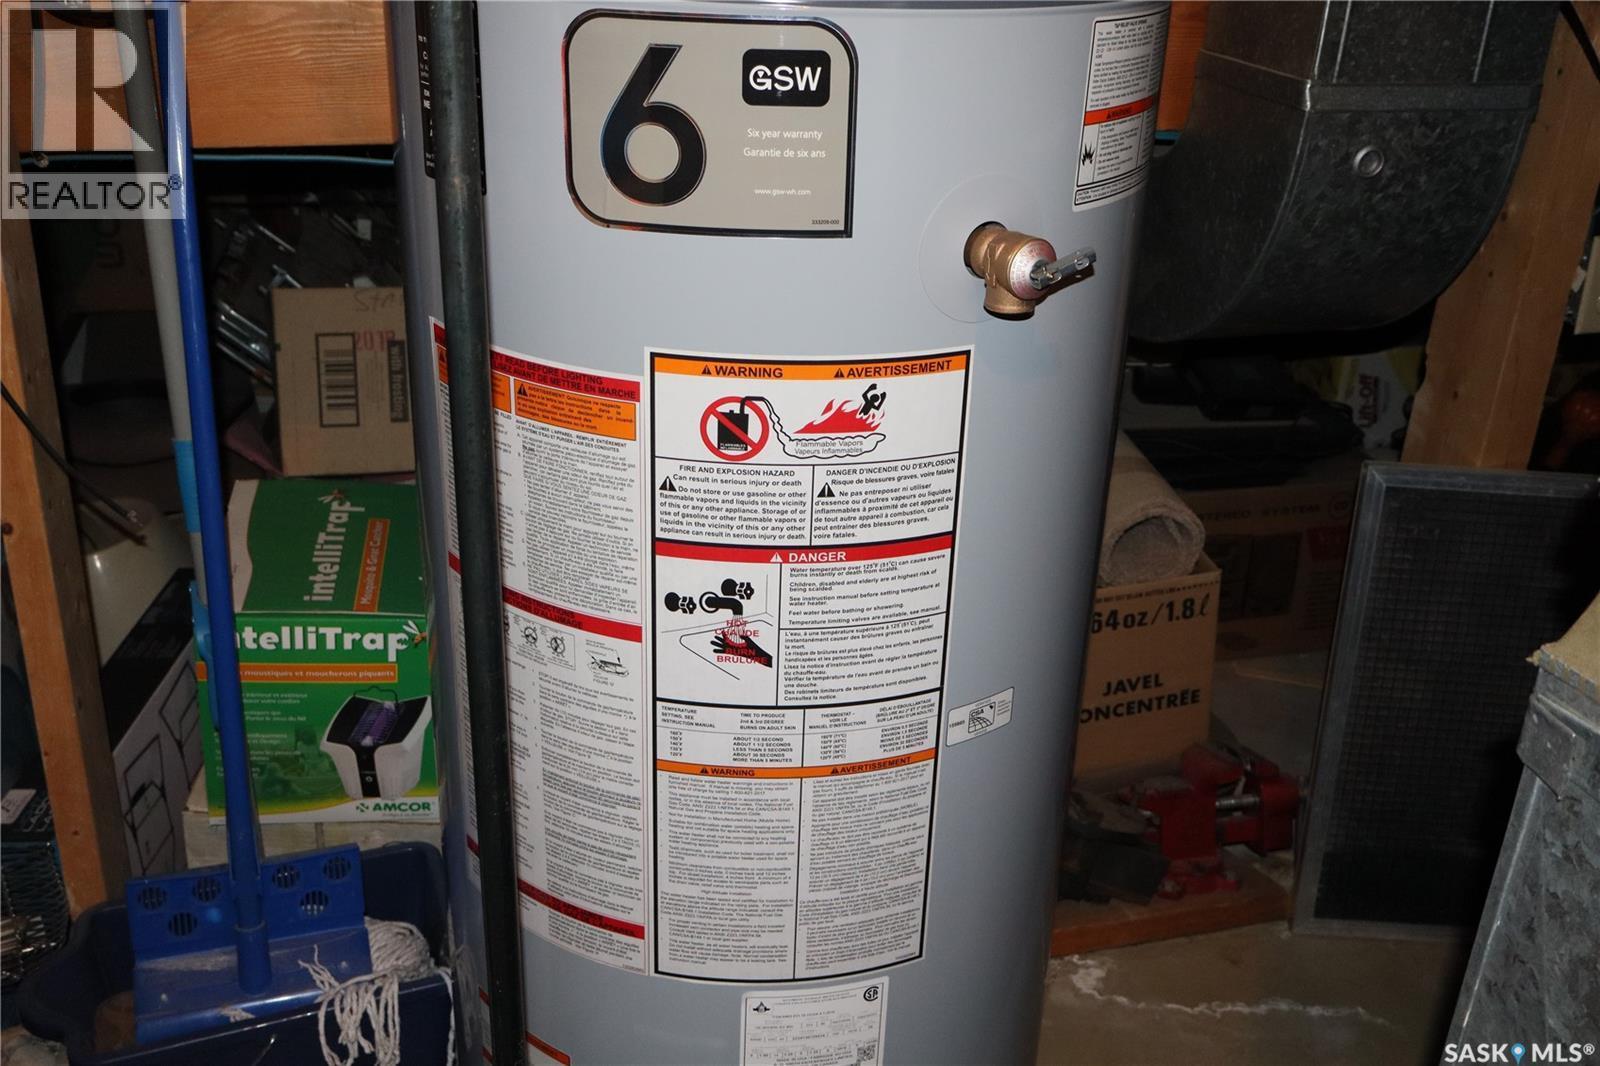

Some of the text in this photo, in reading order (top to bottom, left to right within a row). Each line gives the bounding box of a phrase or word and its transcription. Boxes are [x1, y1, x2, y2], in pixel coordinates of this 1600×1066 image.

[601, 43, 822, 206] 6 GSW
[747, 128, 823, 141] Six year warranty
[744, 147, 826, 158] Garantie de six ans
[715, 360, 952, 378] WARNING AVERTISSEMENT
[562, 370, 603, 385] LIGHTING
[584, 383, 596, 392] EN
[599, 386, 636, 399] MARCHE
[839, 440, 864, 448] Vapors
[716, 468, 761, 476] EXPLOSION
[859, 466, 898, 474] D'INCENDIE
[912, 459, 956, 470] D'EXPLOSION
[673, 473, 687, 481] Can
[720, 477, 747, 485] serious
[749, 478, 770, 488] injury
[831, 478, 854, 487] Risque
[920, 470, 935, 478] voire
[936, 467, 954, 476] fatales
[746, 490, 776, 499] gasoline
[864, 487, 900, 496] entreposer
[910, 482, 932, 490] utiliser
[891, 494, 916, 503] vapeurs
[928, 487, 952, 498] liquides
[660, 491, 694, 502] flammable
[696, 497, 719, 505] vapors
[736, 498, 759, 507] liquids
[782, 499, 806, 508] vicinity
[815, 506, 860, 514] inflammables
[868, 502, 898, 514] proximité
[909, 500, 919, 508] cet
[920, 495, 944, 507] appareil
[668, 501, 680, 509] this
[691, 505, 704, 513] any
[762, 507, 788, 516] Storage
[681, 512, 709, 520] gasoline
[858, 512, 883, 522] appareil
[937, 503, 949, 512] cela
[660, 516, 684, 526] liquids
[694, 520, 706, 528] the
[708, 522, 734, 532] vicinity
[786, 524, 805, 532] other
[660, 526, 690, 535] appliance
[705, 530, 723, 538] result
[758, 532, 777, 542] injury
[304, 500, 365, 602] intelliTrap
[788, 552, 846, 562] DANGER
[236, 626, 409, 662] telliTrap
[359, 670, 394, 678] piquants
[1103, 674, 1164, 697] JAVEL
[1080, 688, 1200, 724] ONCENTRÉE
[710, 756, 912, 777] WARNING AVERTISSEMENT
[372, 802, 432, 812] AMCOR
